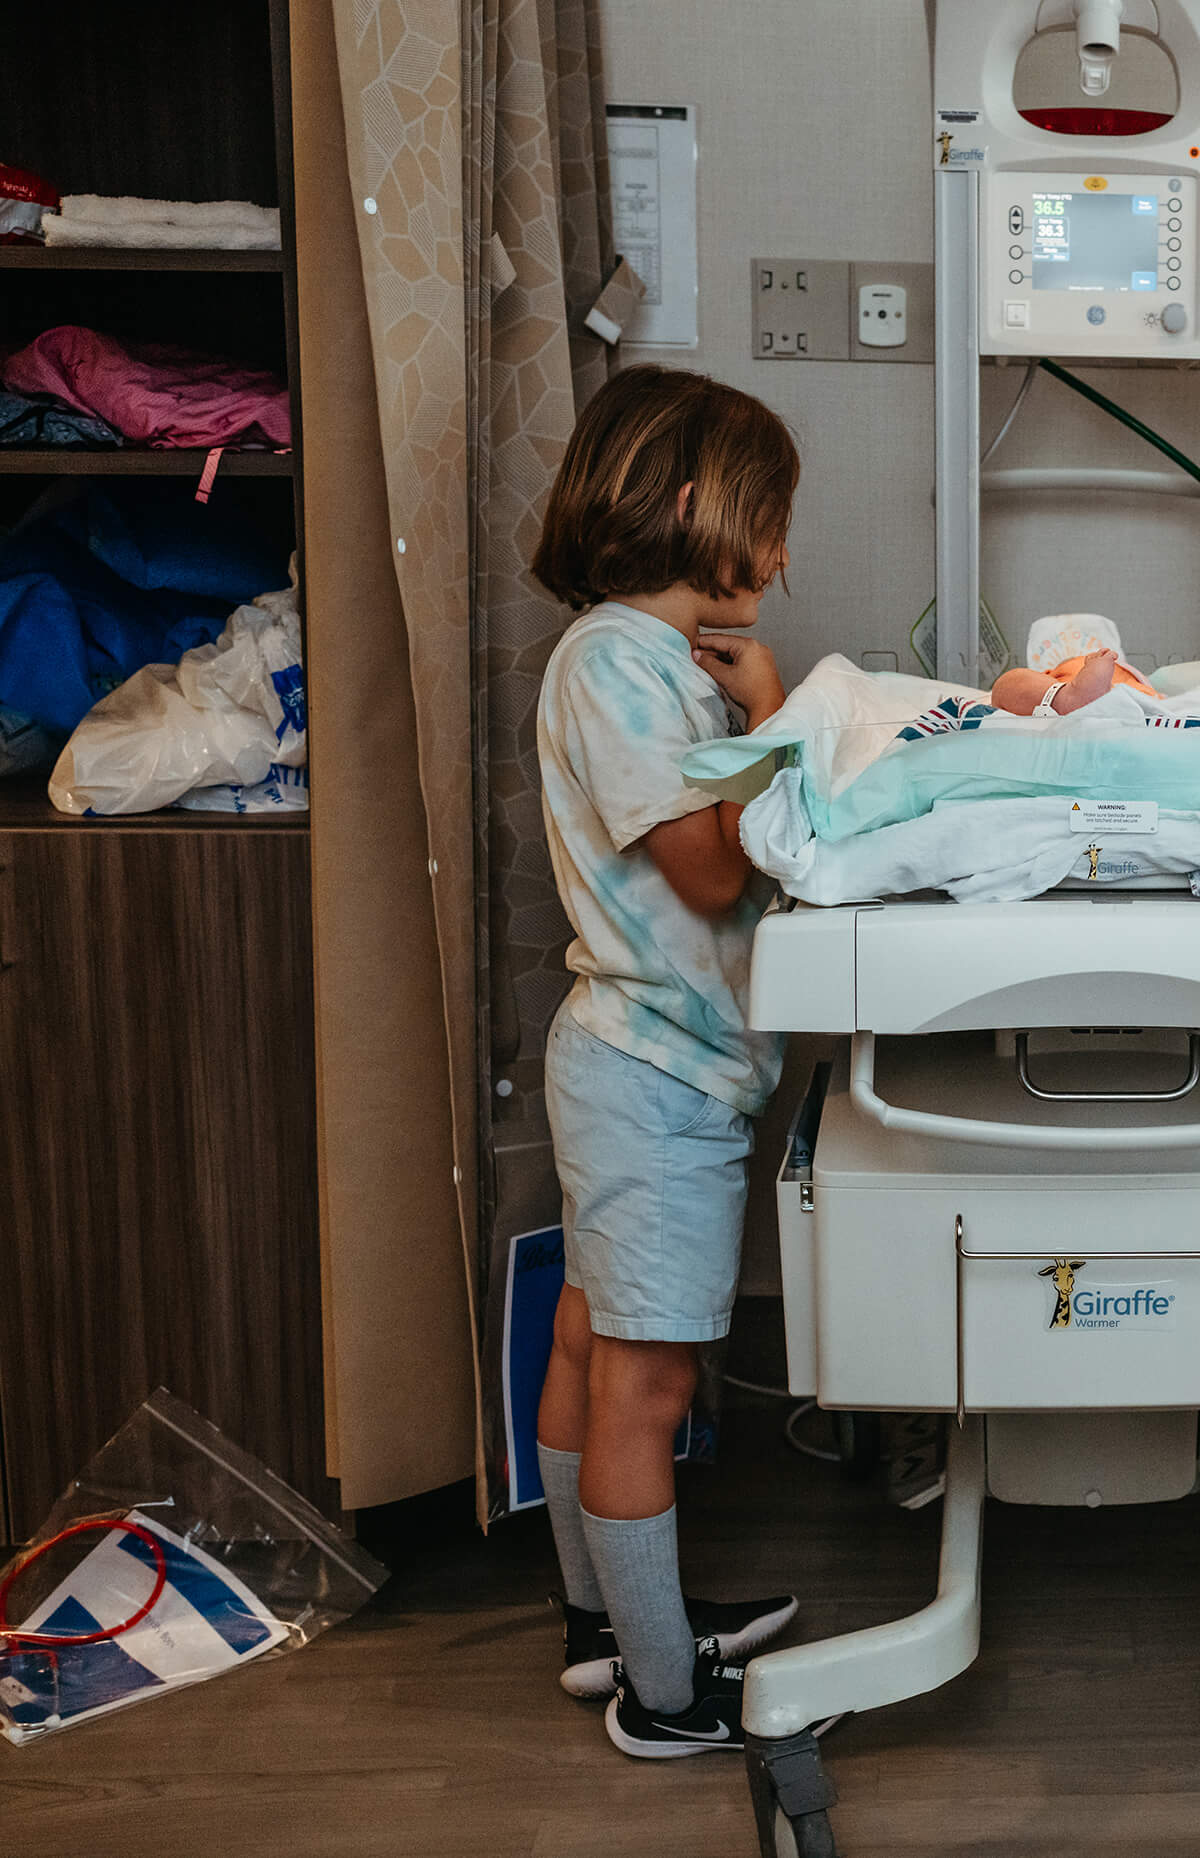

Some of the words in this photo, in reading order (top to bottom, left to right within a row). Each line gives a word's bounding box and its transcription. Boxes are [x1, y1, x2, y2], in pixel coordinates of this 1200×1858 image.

[1034, 201, 1064, 215] 36.5
[1097, 861, 1140, 874] Giraffe
[1074, 1319, 1121, 1328] Warmer
[722, 1666, 745, 1681] NIKE
